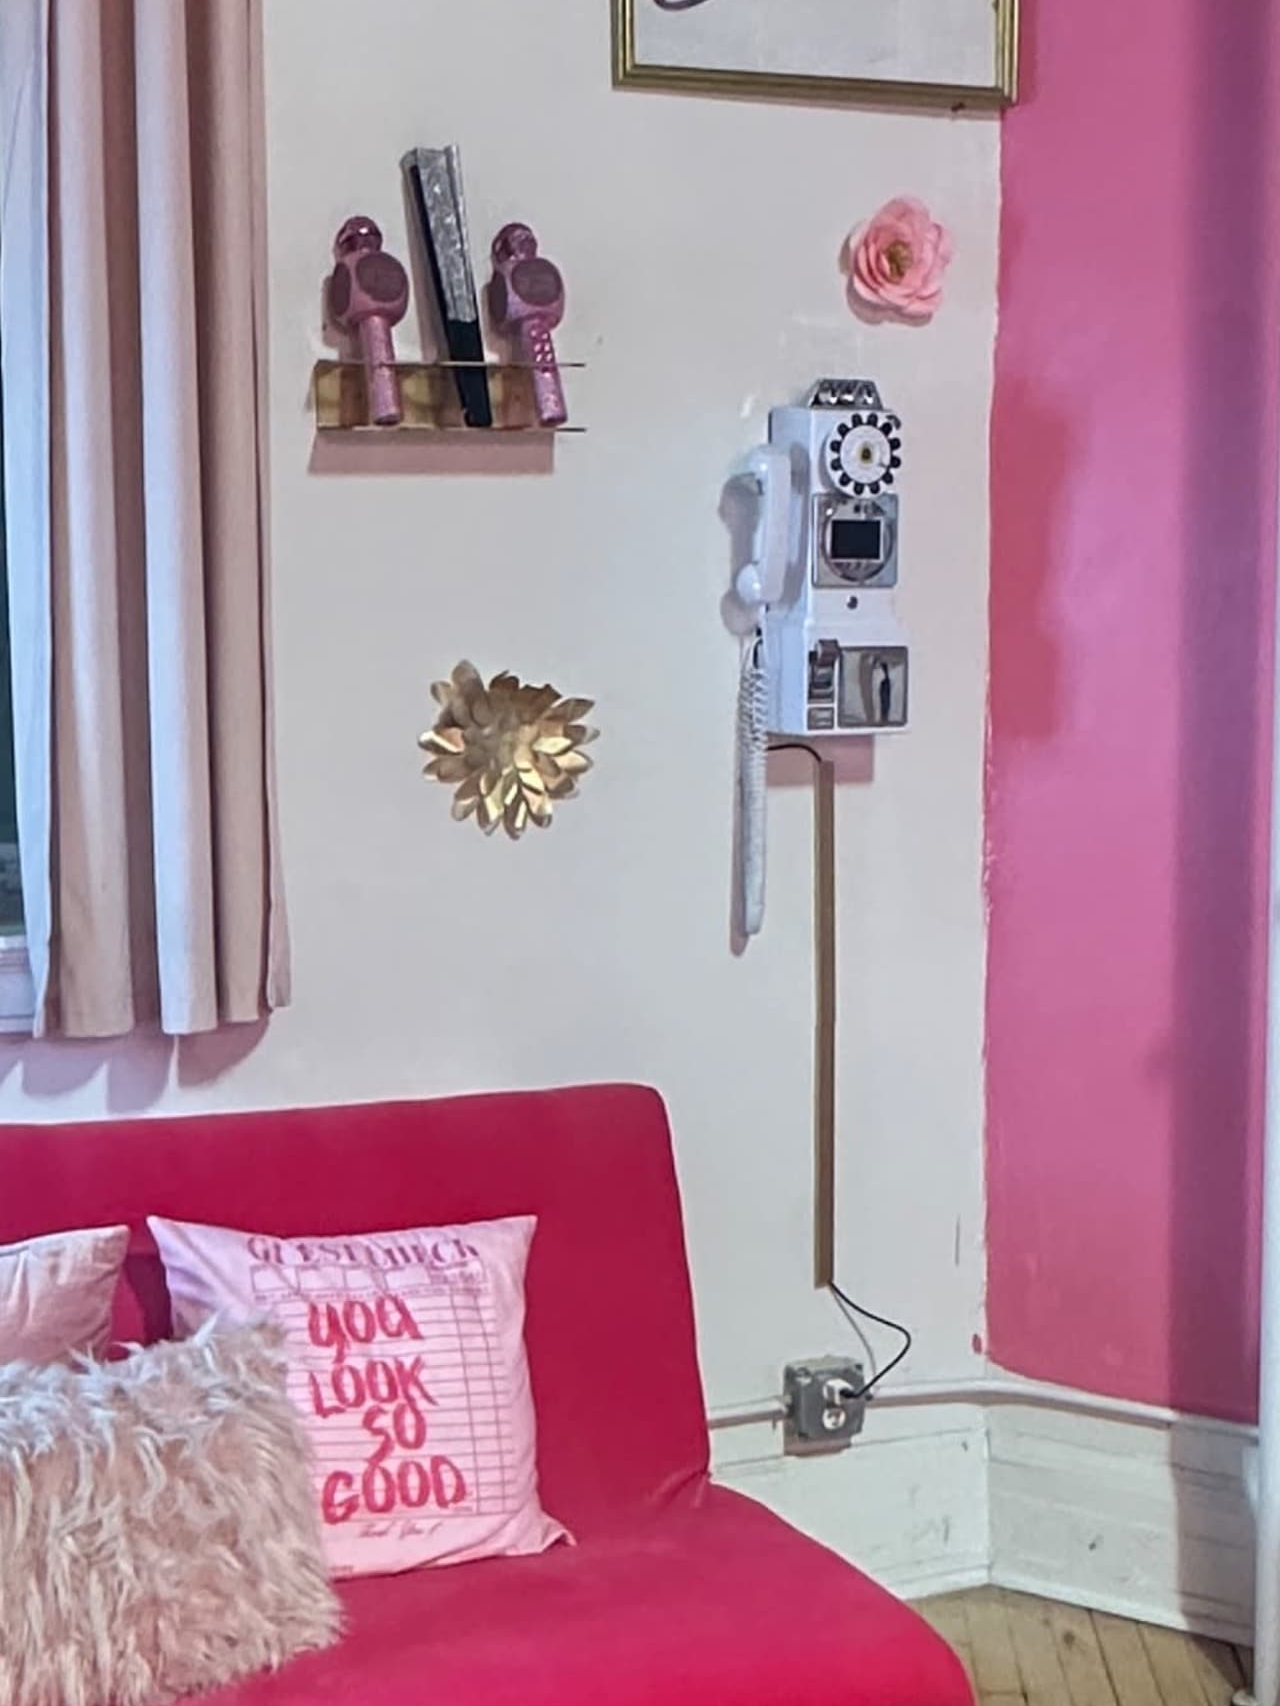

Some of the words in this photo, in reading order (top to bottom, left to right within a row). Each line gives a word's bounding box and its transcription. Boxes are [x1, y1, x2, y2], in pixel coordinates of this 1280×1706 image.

[307, 1293, 425, 1365] YOU
[307, 1356, 440, 1419] LOOK
[361, 1402, 427, 1469] SO
[321, 1454, 468, 1526] GOOD
